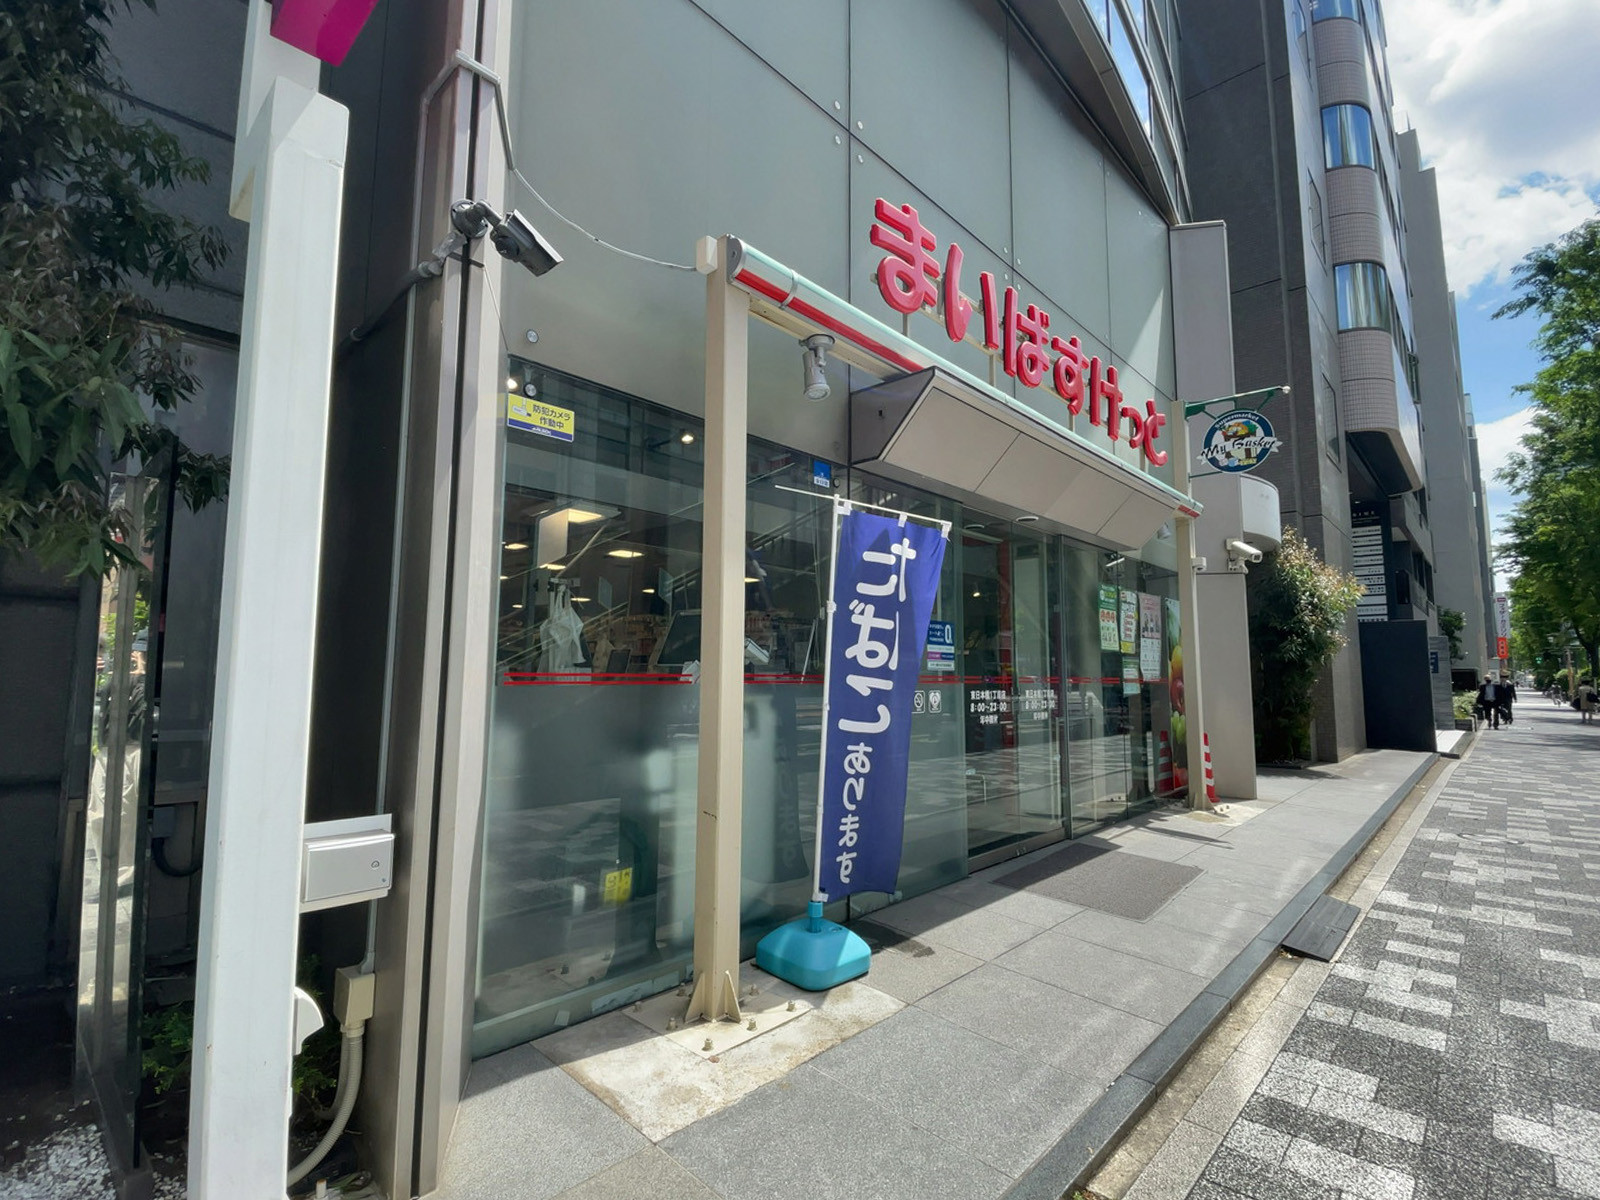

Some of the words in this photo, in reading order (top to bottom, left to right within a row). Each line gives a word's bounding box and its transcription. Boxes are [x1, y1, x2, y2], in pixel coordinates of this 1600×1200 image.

[870, 197, 1168, 467] まいばすけっと
[533, 405, 571, 421] 防犯カメラ
[1214, 413, 1259, 428] Supermarket
[540, 417, 564, 429] 作動中
[1200, 444, 1226, 458] My
[1232, 437, 1275, 449] Basket
